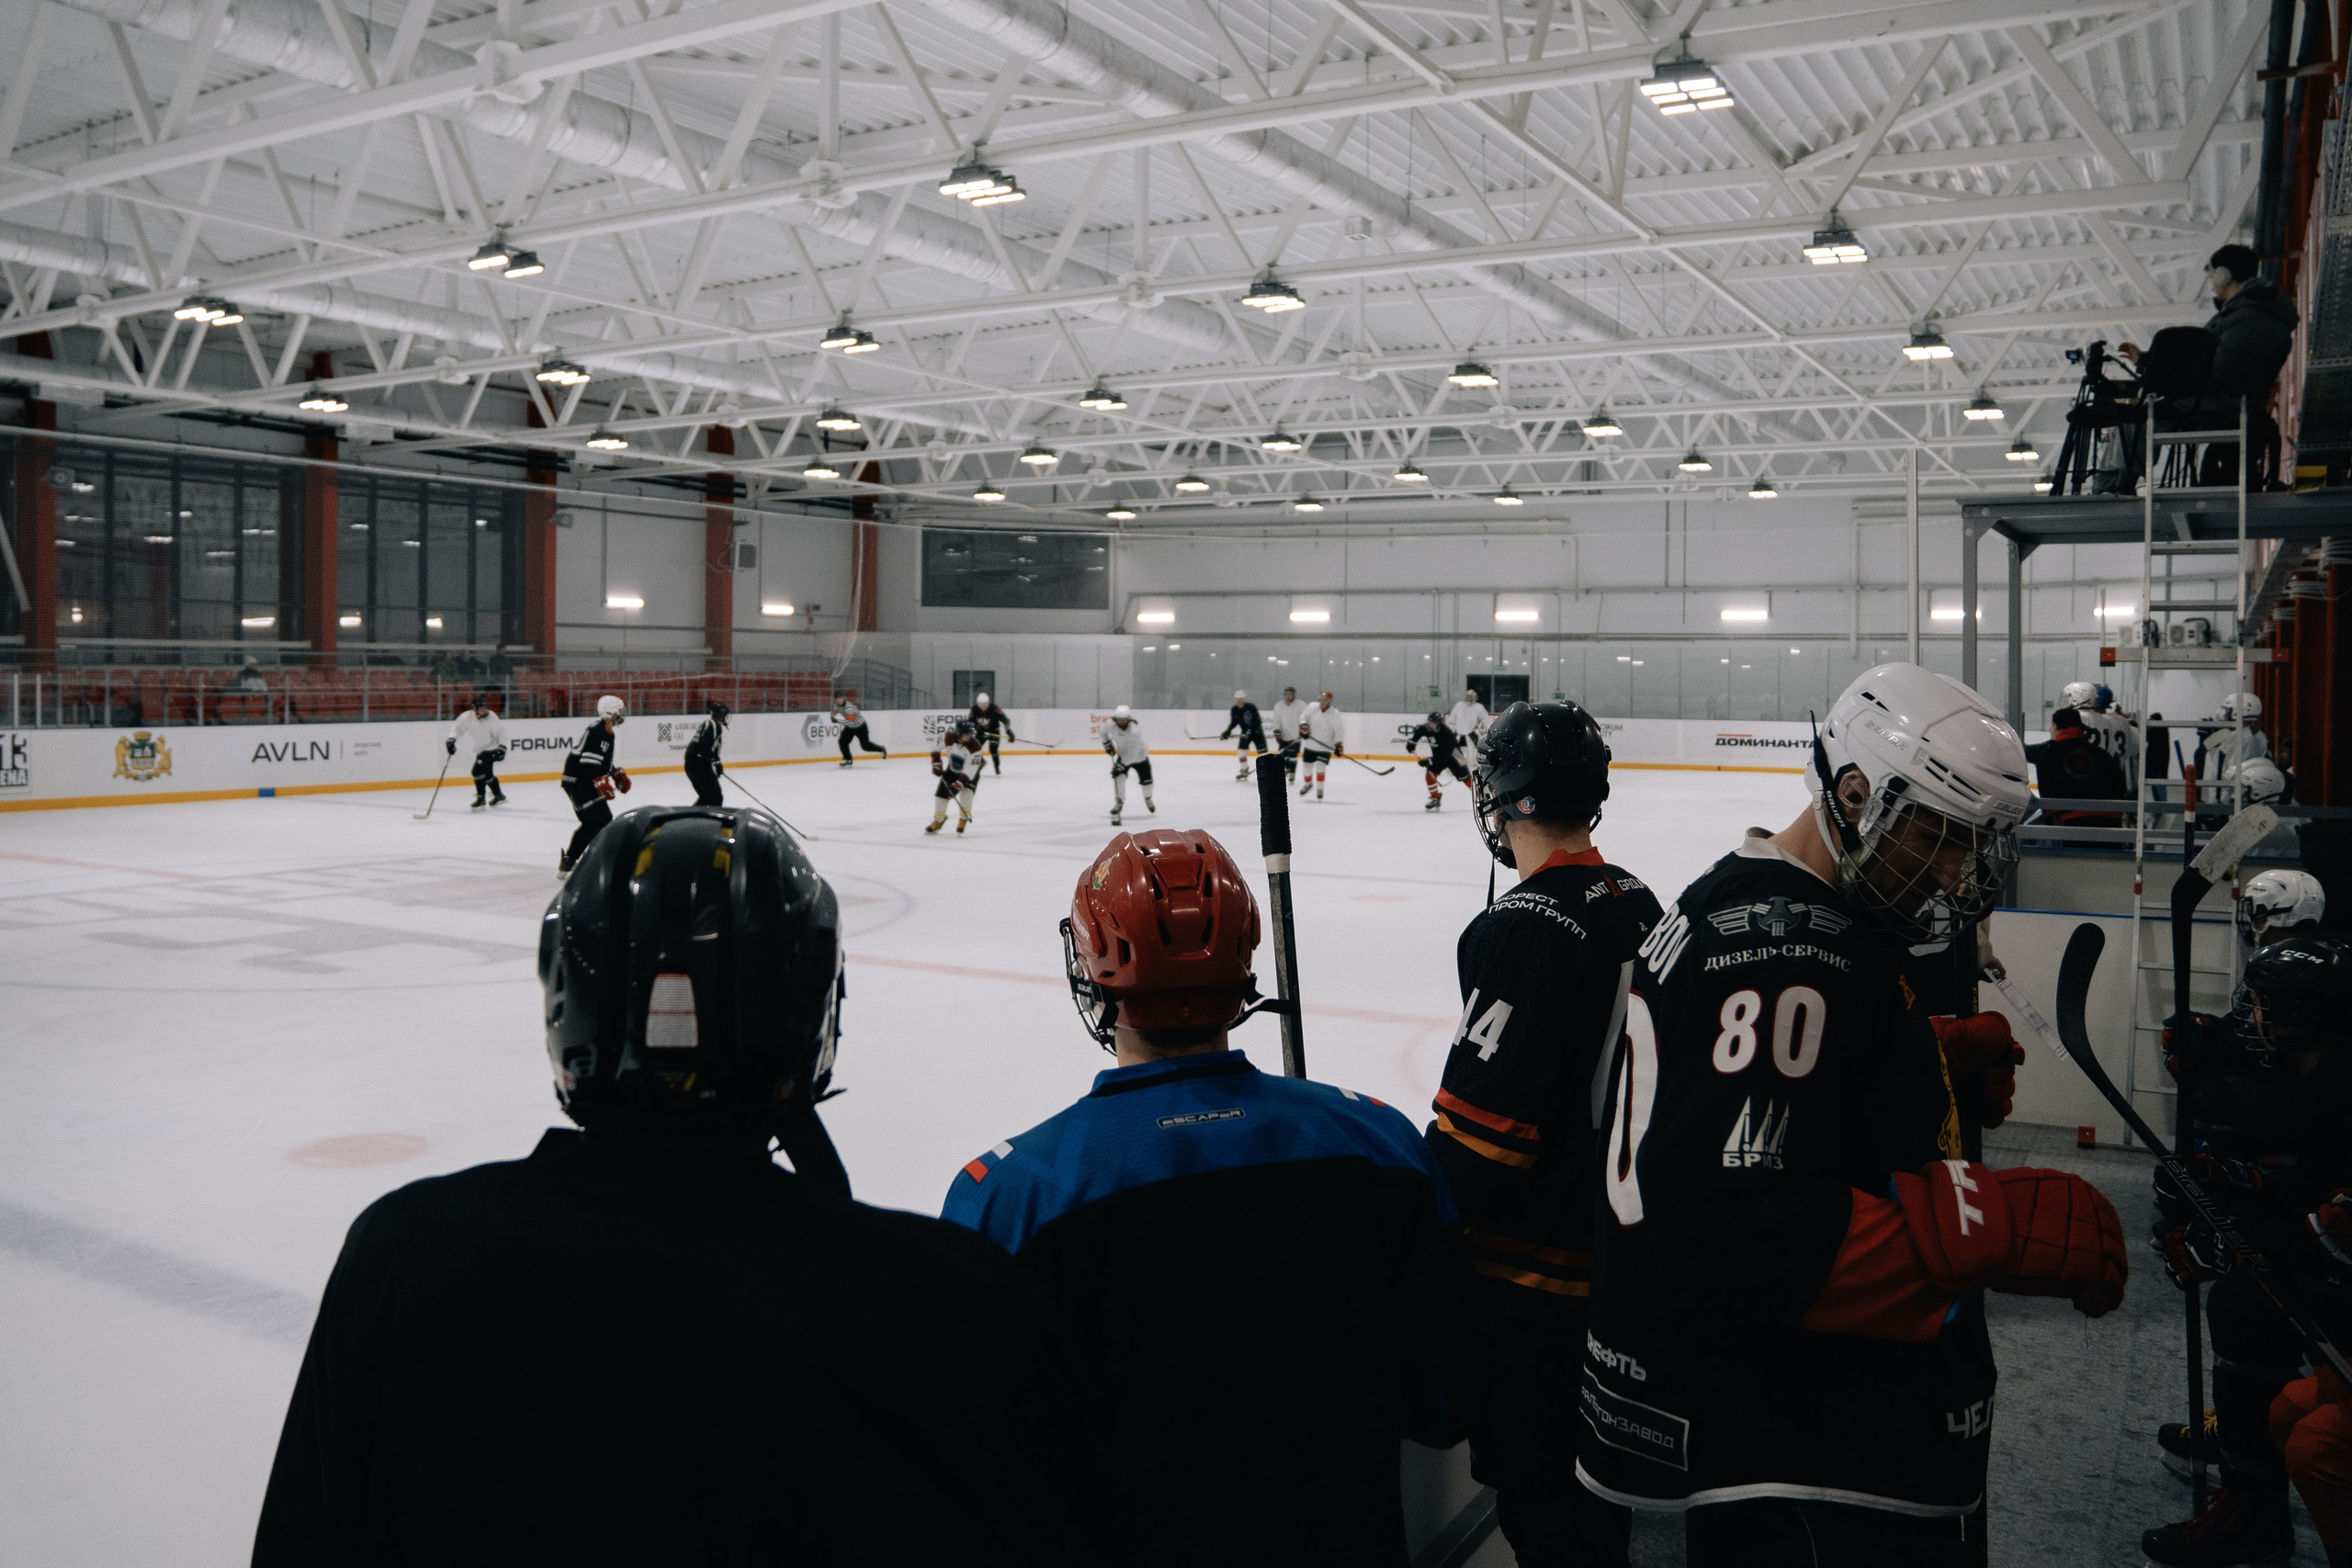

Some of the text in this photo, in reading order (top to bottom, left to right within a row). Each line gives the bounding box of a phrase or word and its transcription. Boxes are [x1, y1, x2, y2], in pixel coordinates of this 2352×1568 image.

[810, 725, 842, 738] BEVO
[1599, 722, 1623, 730] ORUM
[251, 740, 330, 762] AVLN
[510, 737, 574, 751] FORUM
[1714, 737, 1815, 749] ДОМИНАНТА
[1616, 877, 1647, 891] GROU
[1487, 900, 1587, 940] ПРОМ ГРУПП
[1704, 944, 1851, 972] ДИЗЕЛЬ-СЕРВИС
[2279, 948, 2324, 964] CCM
[1712, 985, 1826, 1078] 80
[1722, 1152, 1784, 1170] БРИЗ
